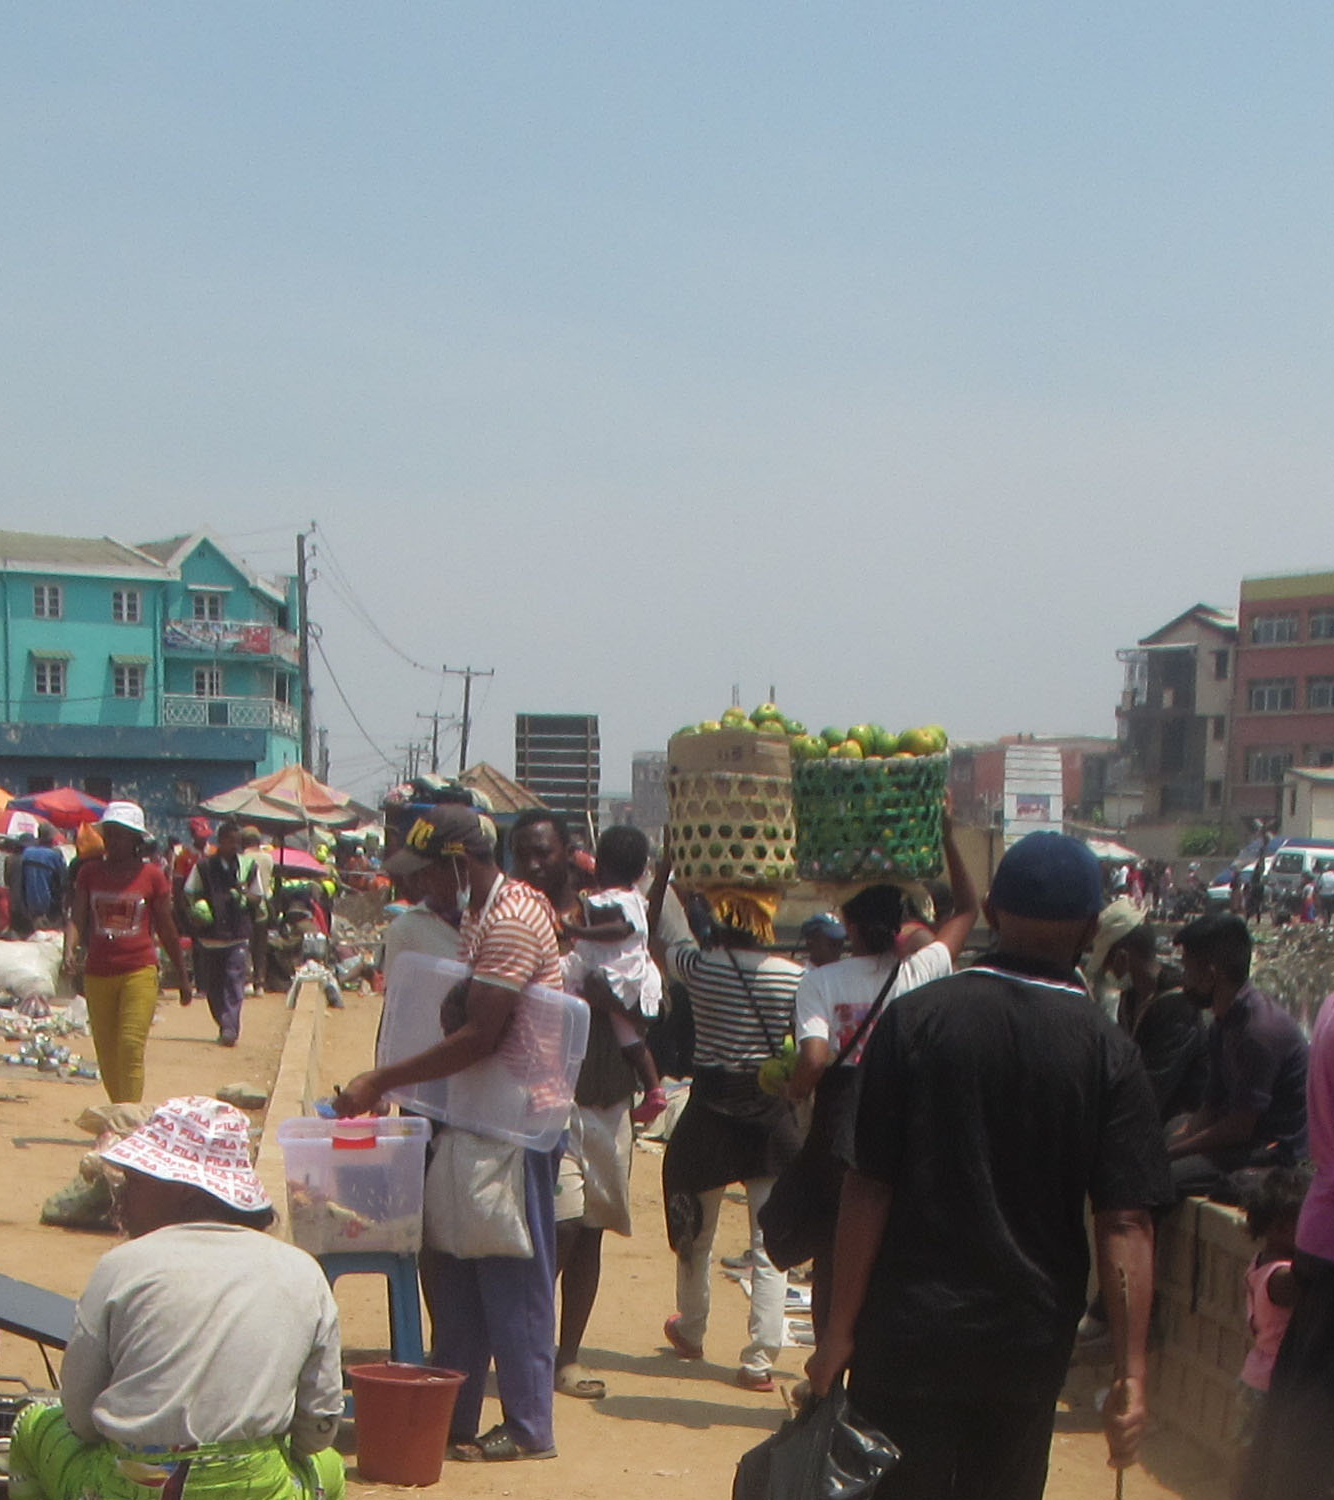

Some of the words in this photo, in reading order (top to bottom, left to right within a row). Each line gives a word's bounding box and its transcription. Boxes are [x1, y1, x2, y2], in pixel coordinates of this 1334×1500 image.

[186, 1111, 210, 1129] FILA
[215, 1122, 240, 1132] FILA
[179, 1127, 205, 1144] FILA
[210, 1139, 236, 1150] FILA
[172, 1144, 199, 1163] FILA
[134, 1157, 157, 1171] FILA
[205, 1156, 231, 1167] FILA
[207, 1180, 229, 1193] FILA
